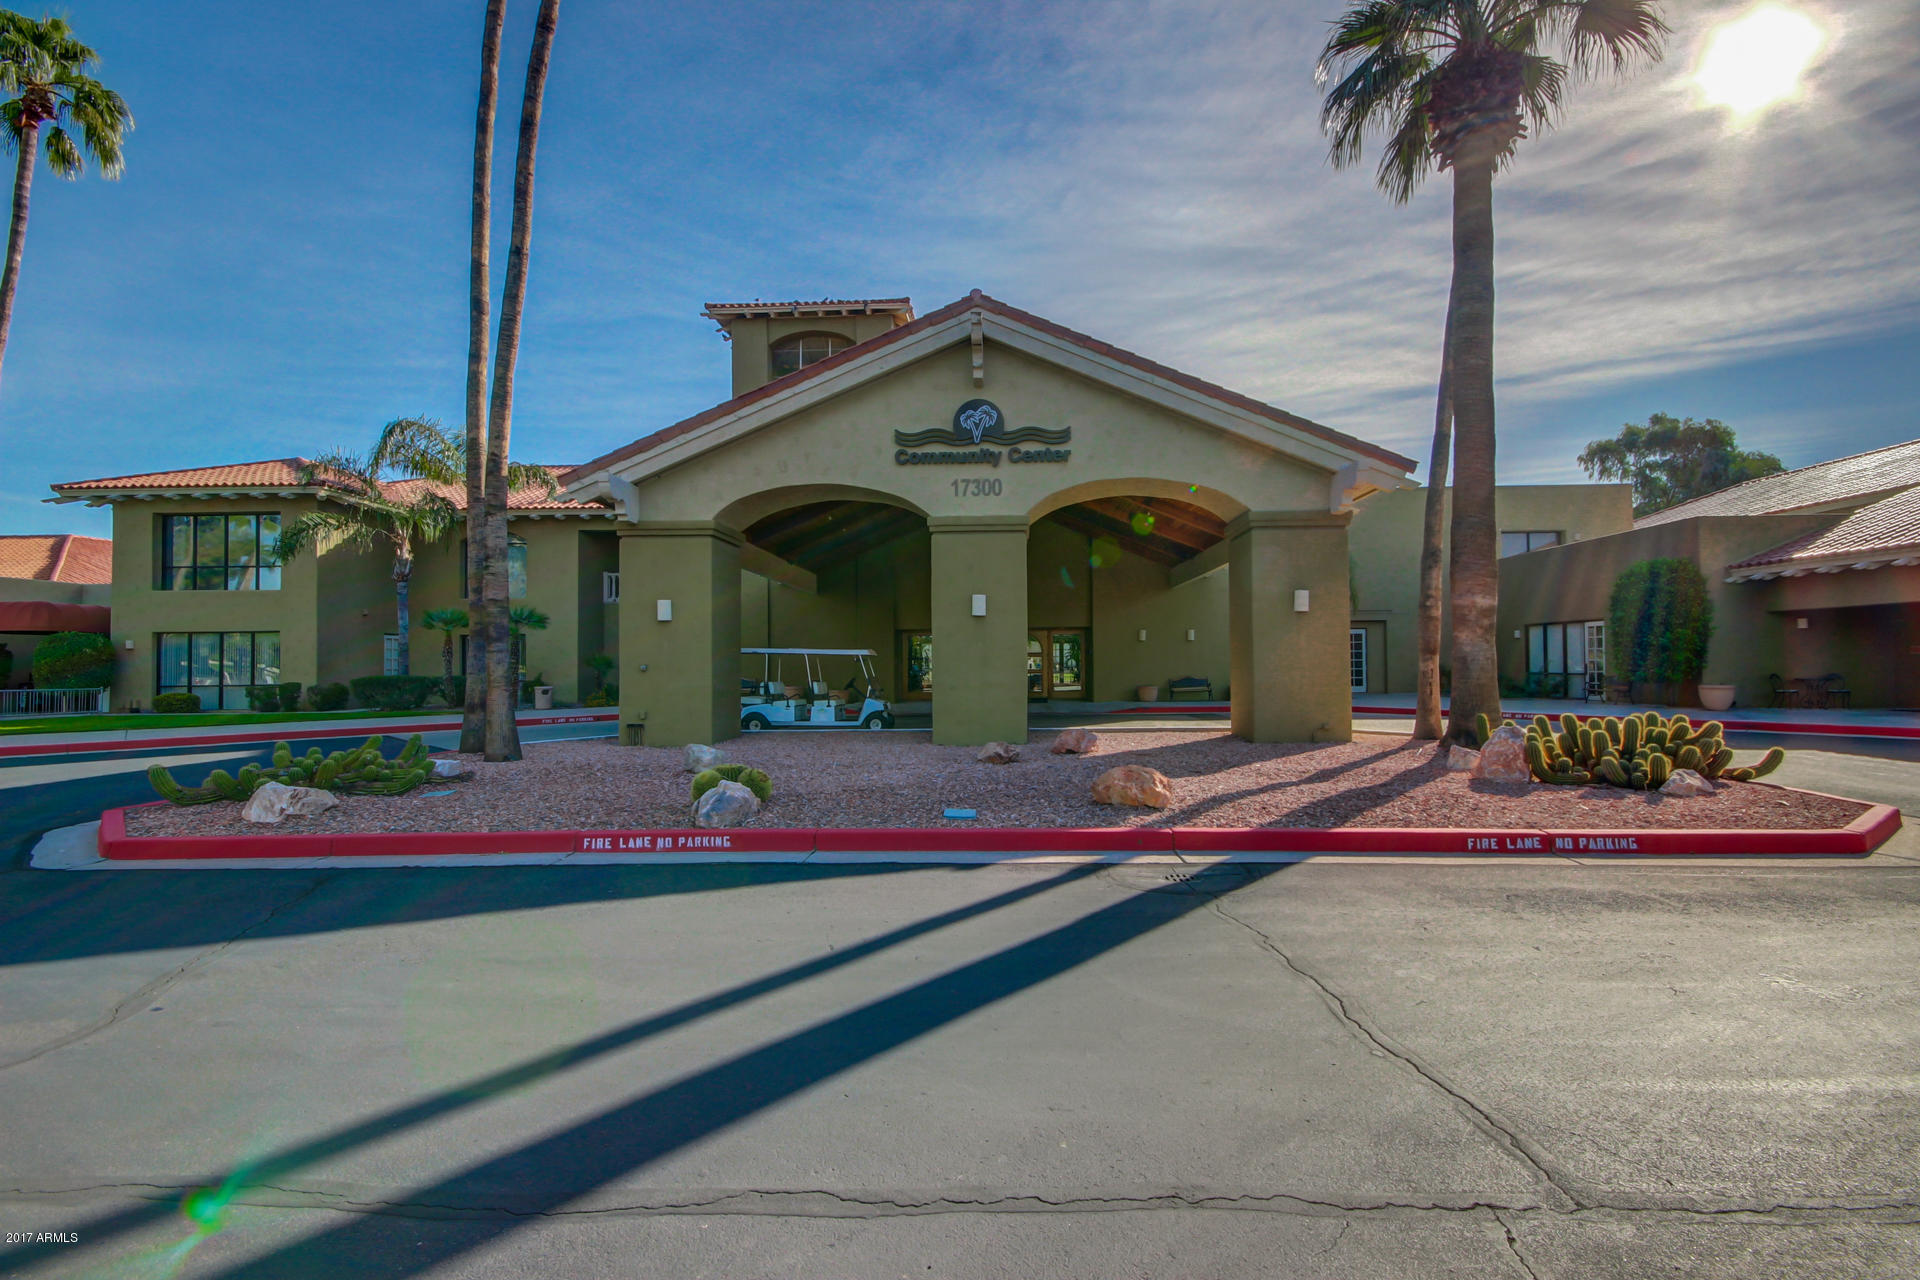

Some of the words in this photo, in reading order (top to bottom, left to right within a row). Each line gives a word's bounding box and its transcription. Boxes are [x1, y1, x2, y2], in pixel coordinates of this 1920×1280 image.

[895, 448, 1002, 467] Community
[1008, 447, 1072, 464] Center
[952, 478, 1003, 496] 17300
[583, 837, 612, 849] FIRE
[620, 836, 652, 849] LANE
[657, 837, 672, 849] NO
[678, 836, 731, 848] PARKING
[1467, 838, 1499, 850] FIRE
[1507, 837, 1542, 849] LANE
[1555, 837, 1573, 849] NO
[1579, 837, 1638, 850] PARKING
